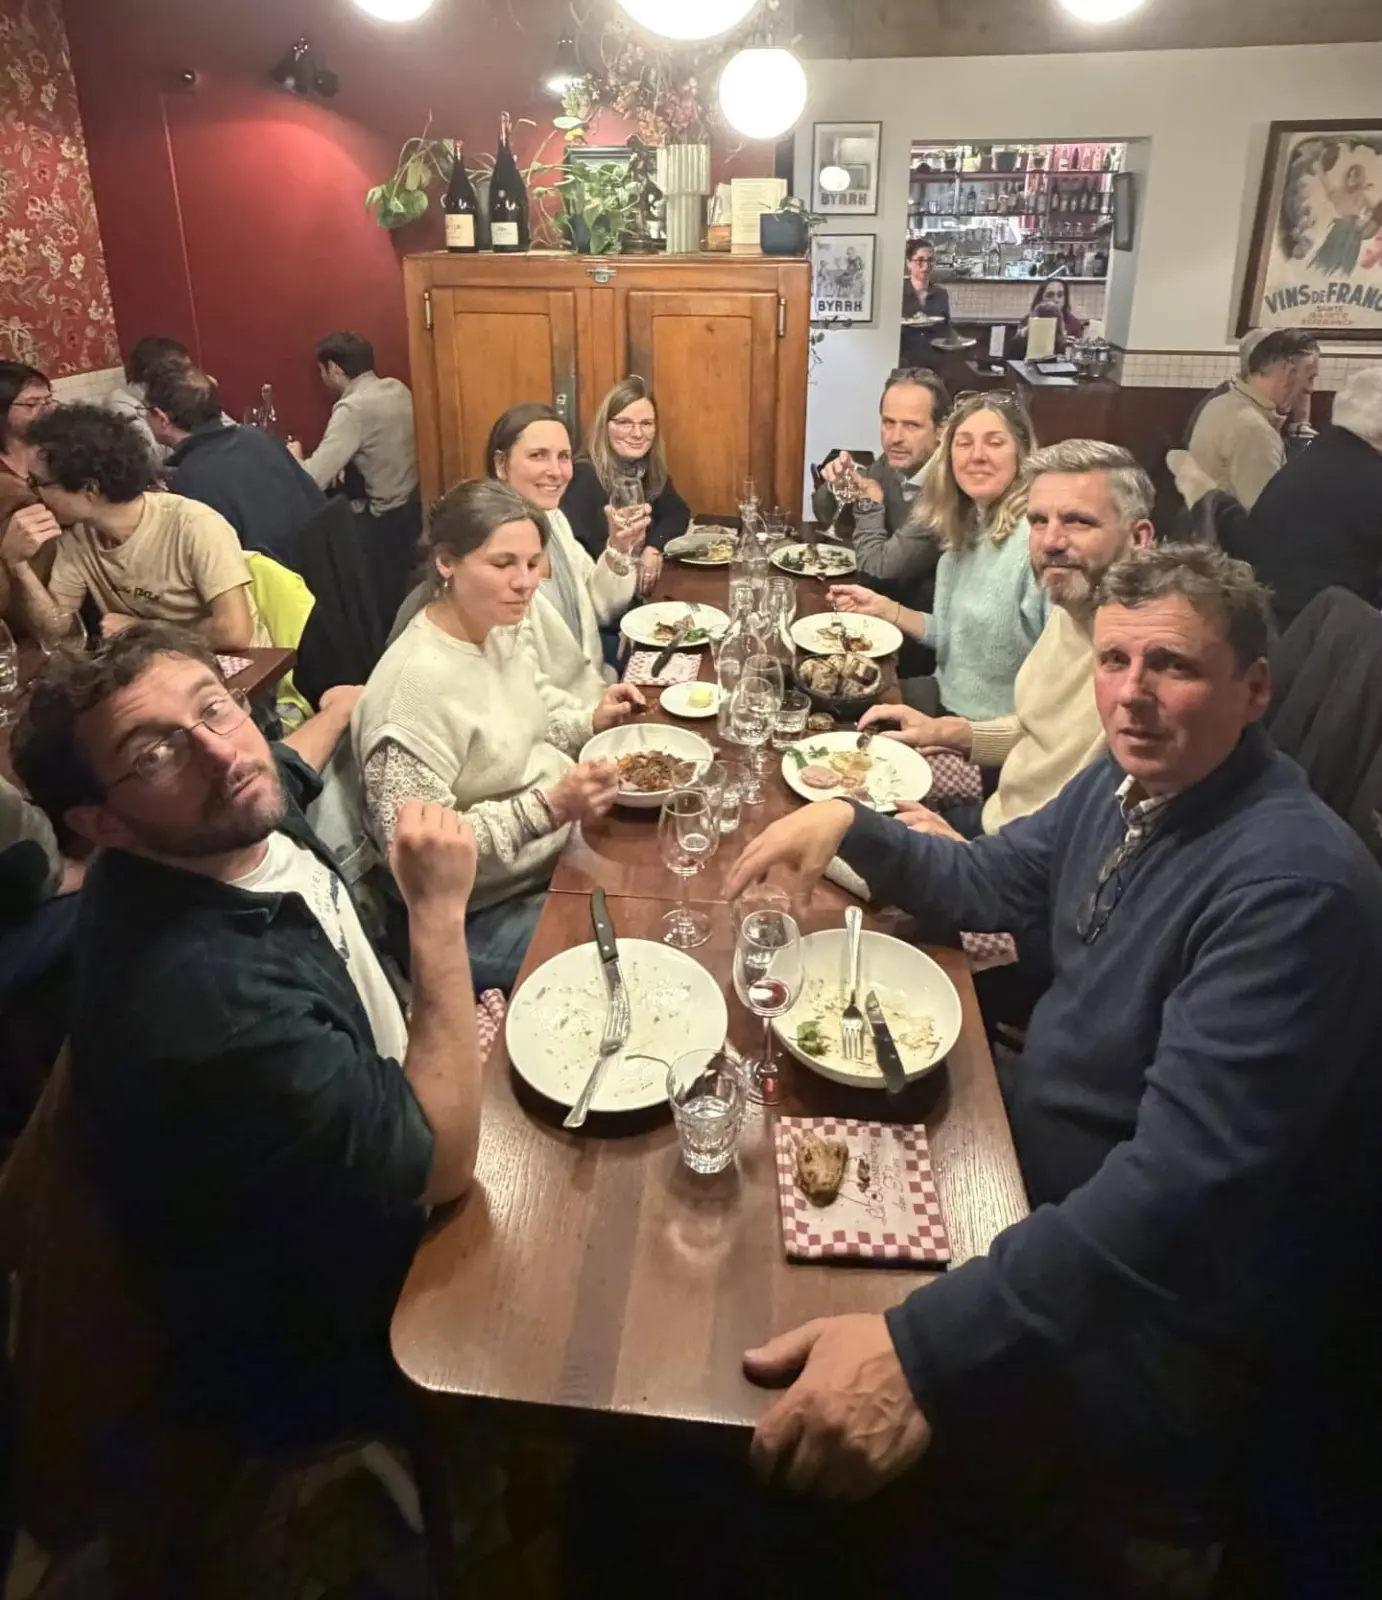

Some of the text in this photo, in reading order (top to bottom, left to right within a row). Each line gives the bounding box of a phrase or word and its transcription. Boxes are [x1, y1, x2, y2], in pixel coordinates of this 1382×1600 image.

[820, 192, 867, 206] BYRRH
[818, 300, 862, 312] BYRRH
[1264, 284, 1311, 314] VINS
[1311, 290, 1326, 304] DE
